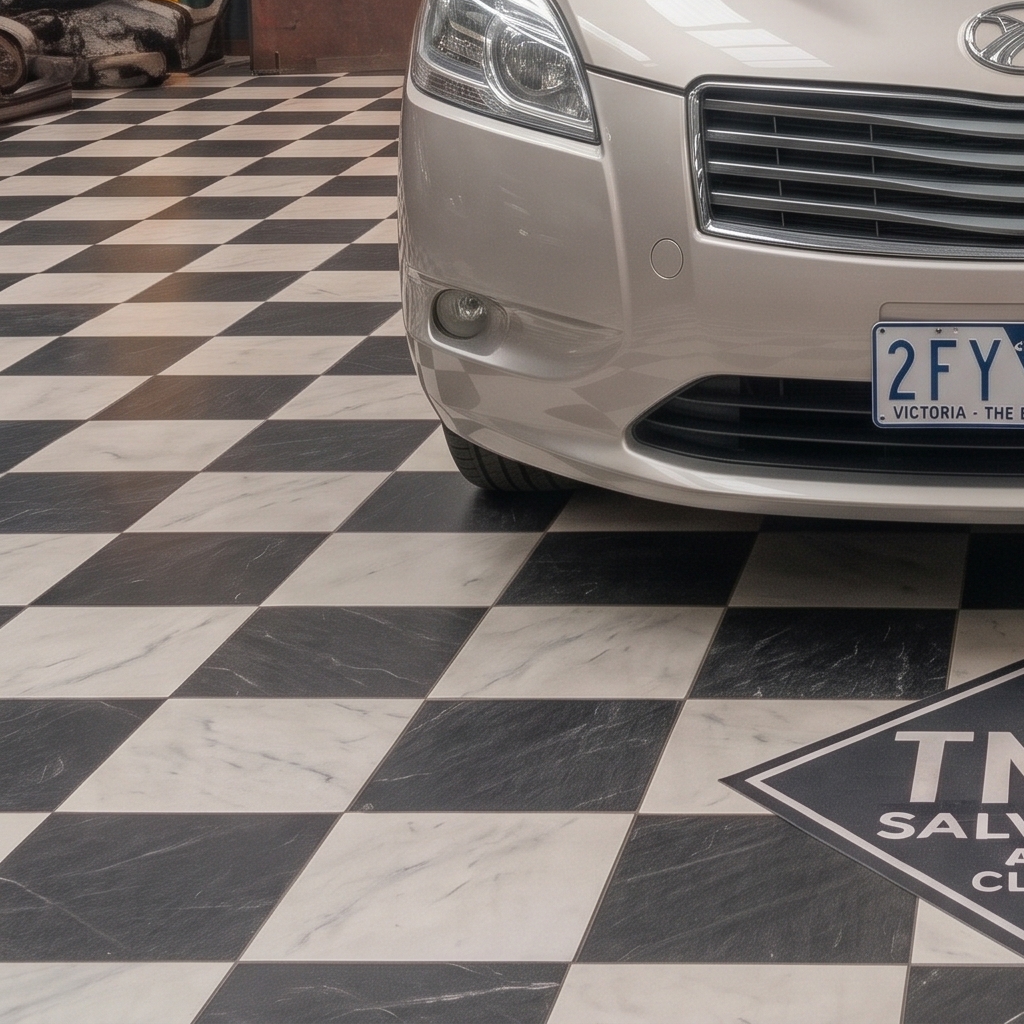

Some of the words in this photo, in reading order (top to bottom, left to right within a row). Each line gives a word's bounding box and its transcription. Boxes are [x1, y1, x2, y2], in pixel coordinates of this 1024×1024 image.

[887, 338, 1002, 402] 2FY
[893, 405, 967, 420] VICTORIA
[984, 406, 1014, 420] THE
